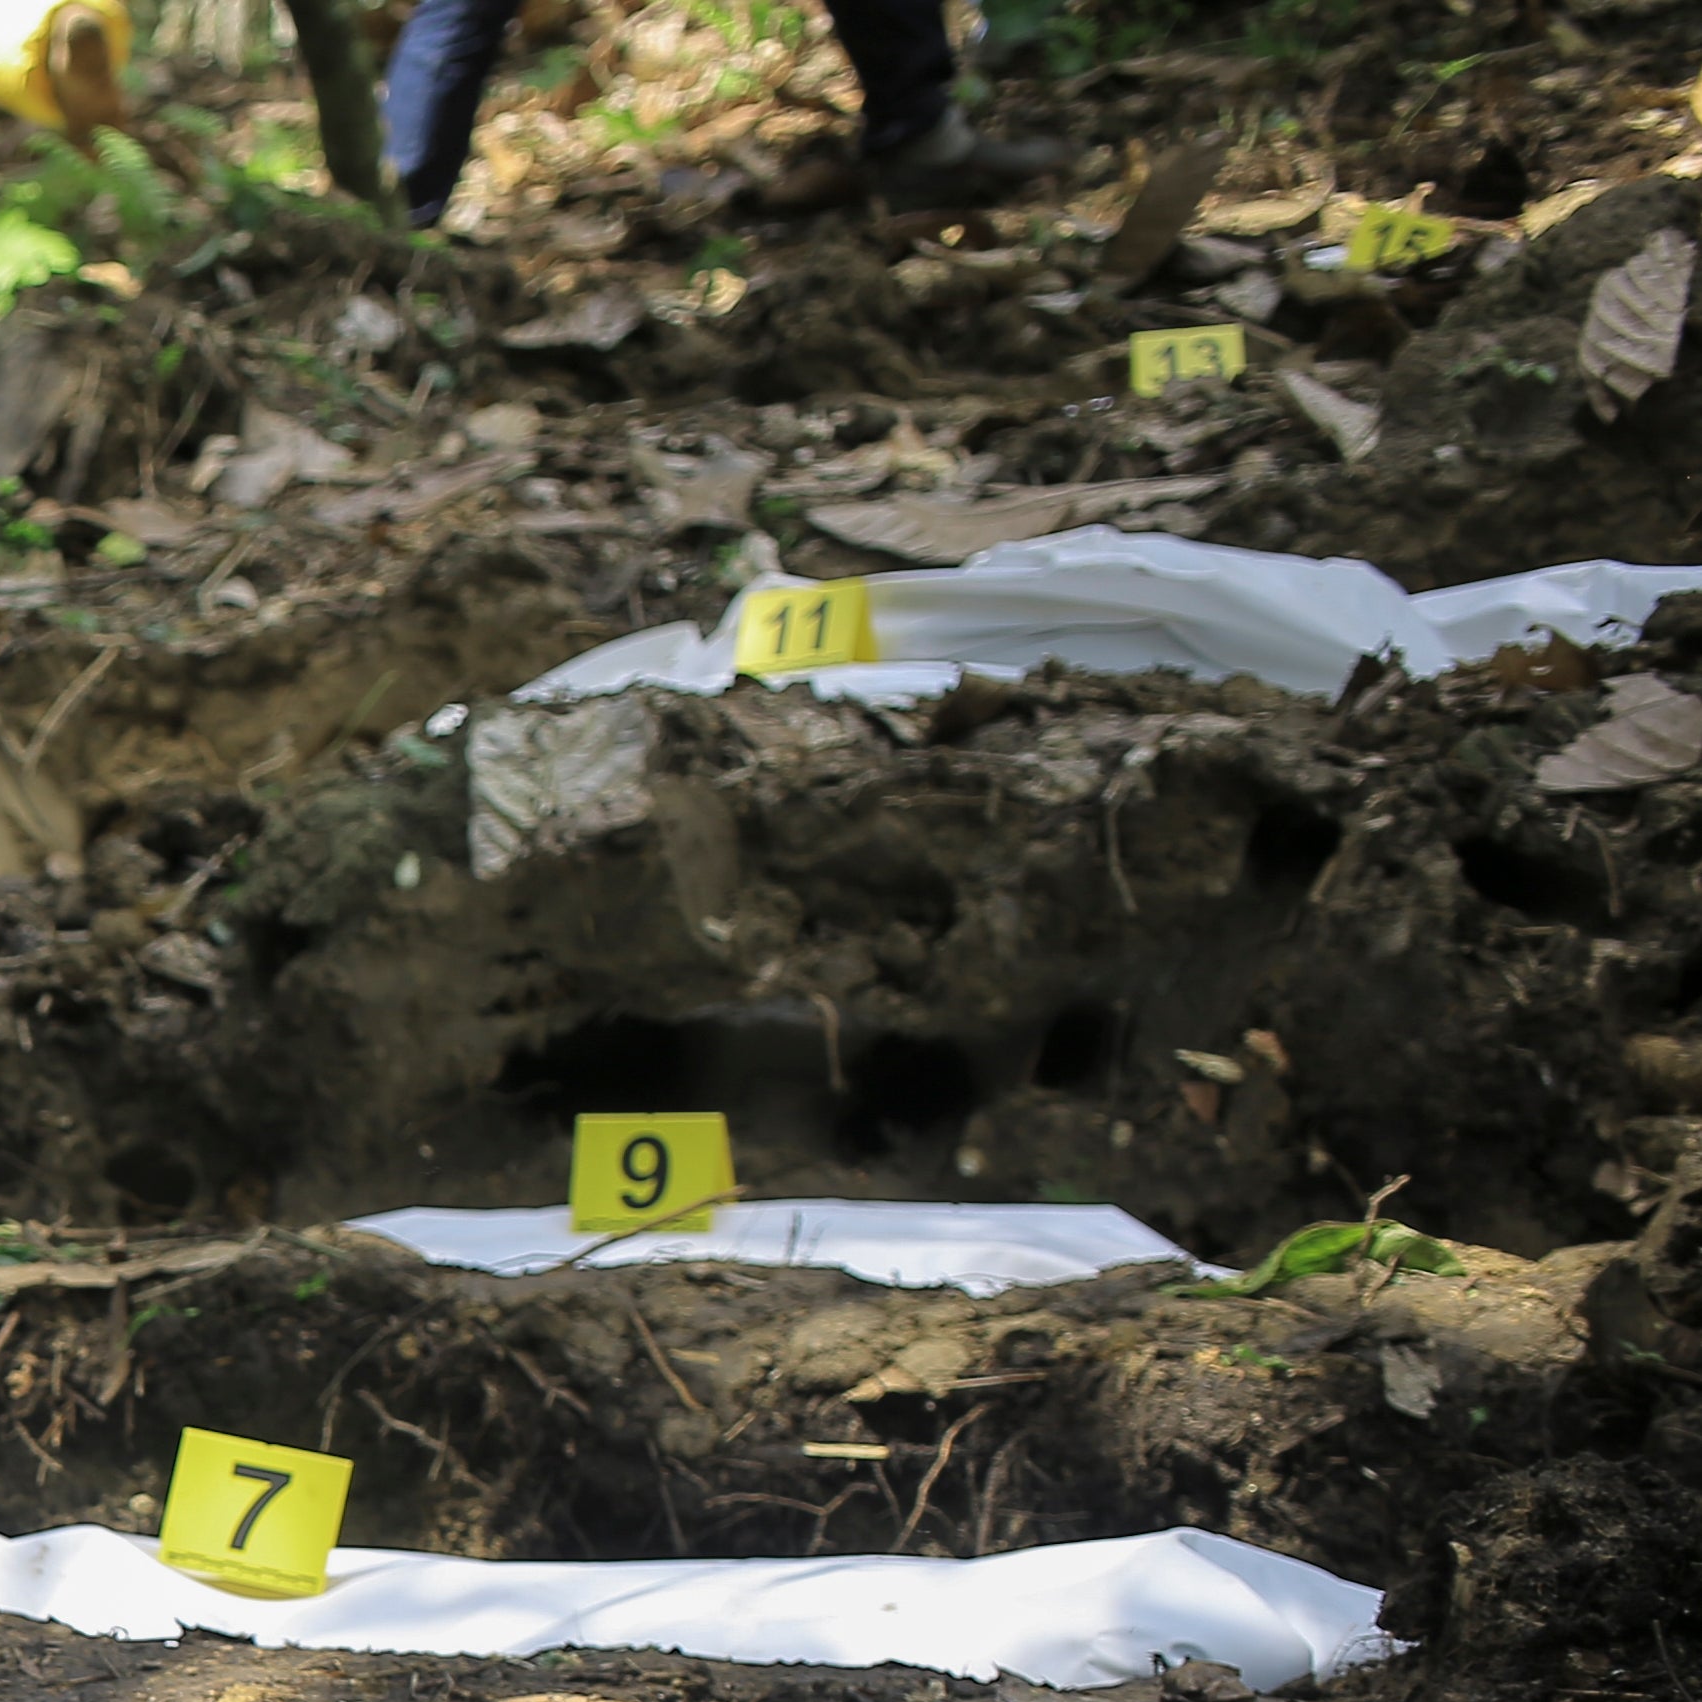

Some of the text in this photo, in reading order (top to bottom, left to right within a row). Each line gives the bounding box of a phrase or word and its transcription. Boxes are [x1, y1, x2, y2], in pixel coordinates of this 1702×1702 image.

[1157, 336, 1225, 380] 13
[768, 599, 830, 654] 11
[619, 1133, 671, 1211] 9
[230, 1464, 291, 1550] 7
